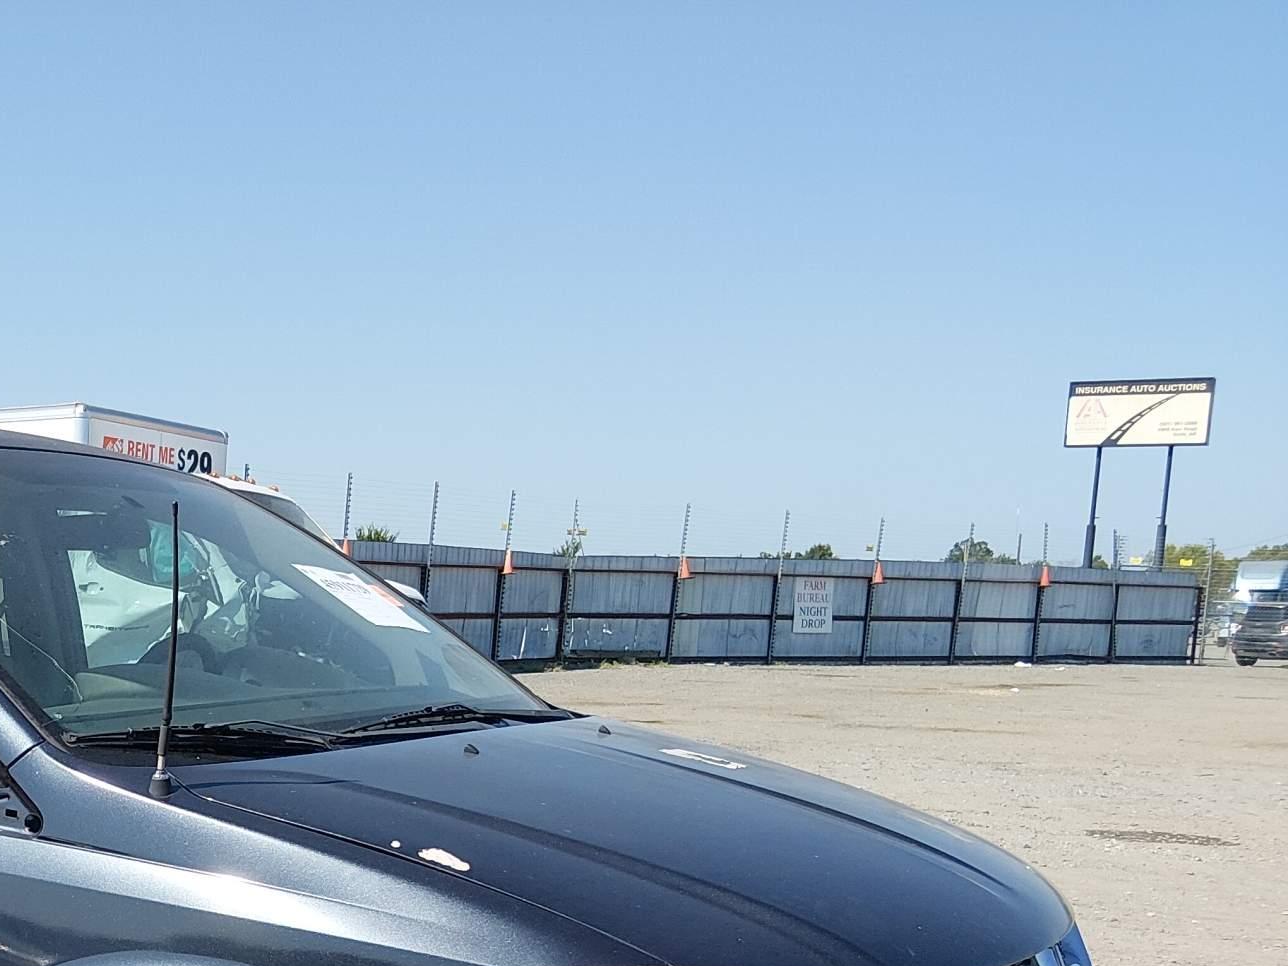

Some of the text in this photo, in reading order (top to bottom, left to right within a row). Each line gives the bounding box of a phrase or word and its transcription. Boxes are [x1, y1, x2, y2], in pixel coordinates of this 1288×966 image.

[1075, 382, 1207, 395] INSURANCE AUTO AUCTIONS
[127, 440, 156, 461] RENT
[158, 445, 175, 465] ME
[803, 580, 826, 591] FARM
[797, 592, 829, 603] BUREAU
[799, 606, 828, 617] NIGHT
[801, 618, 826, 629] DROP
